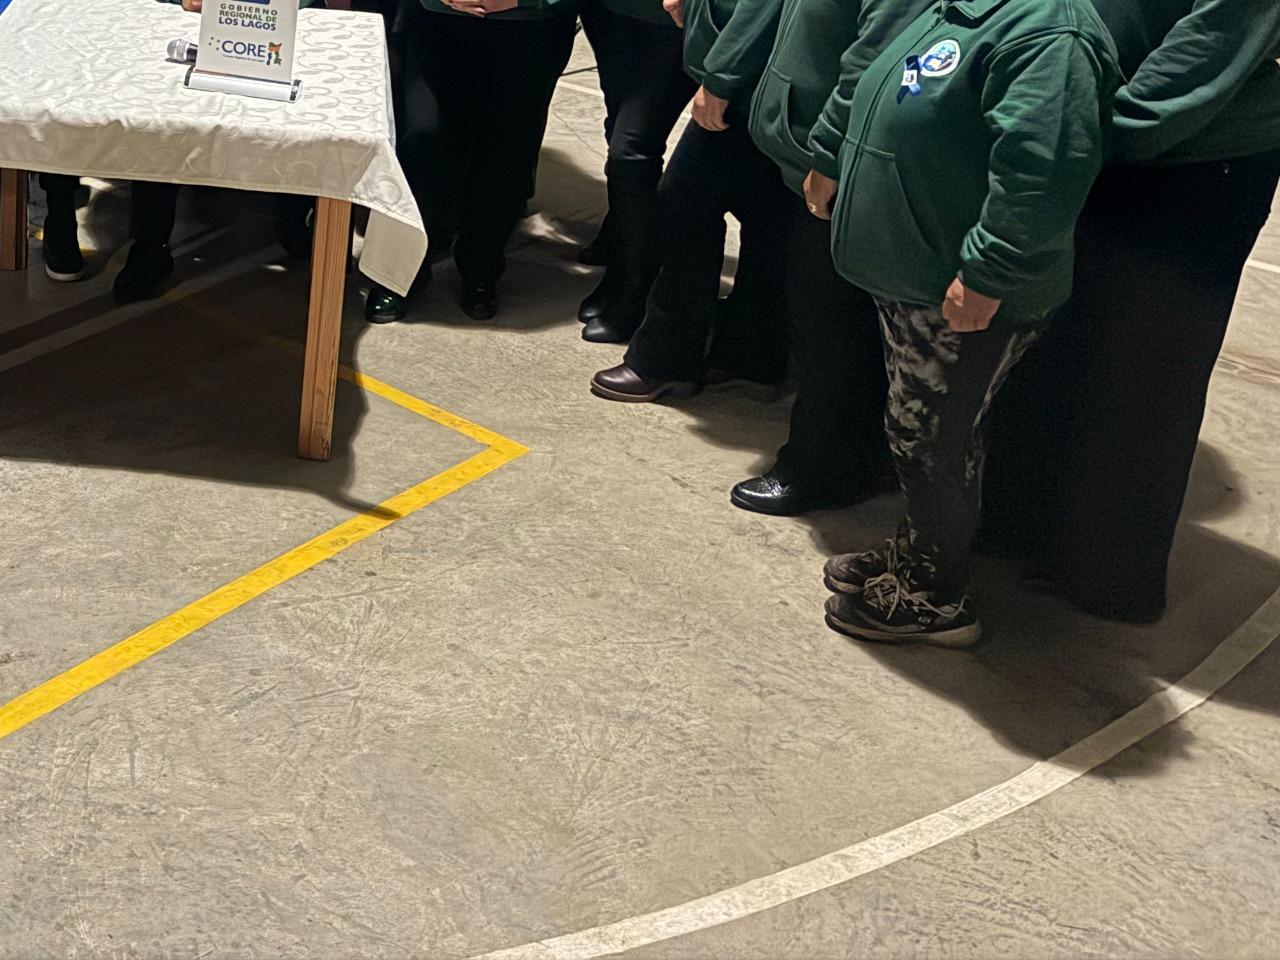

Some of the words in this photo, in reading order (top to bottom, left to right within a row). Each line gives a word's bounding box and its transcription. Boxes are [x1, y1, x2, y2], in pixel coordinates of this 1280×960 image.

[220, 3, 278, 16] GOBIERNO
[219, 10, 263, 21] REGIONAL
[266, 15, 277, 23] DE
[218, 17, 239, 26] LOS
[241, 19, 277, 31] LAGOS
[221, 40, 266, 58] CORE
